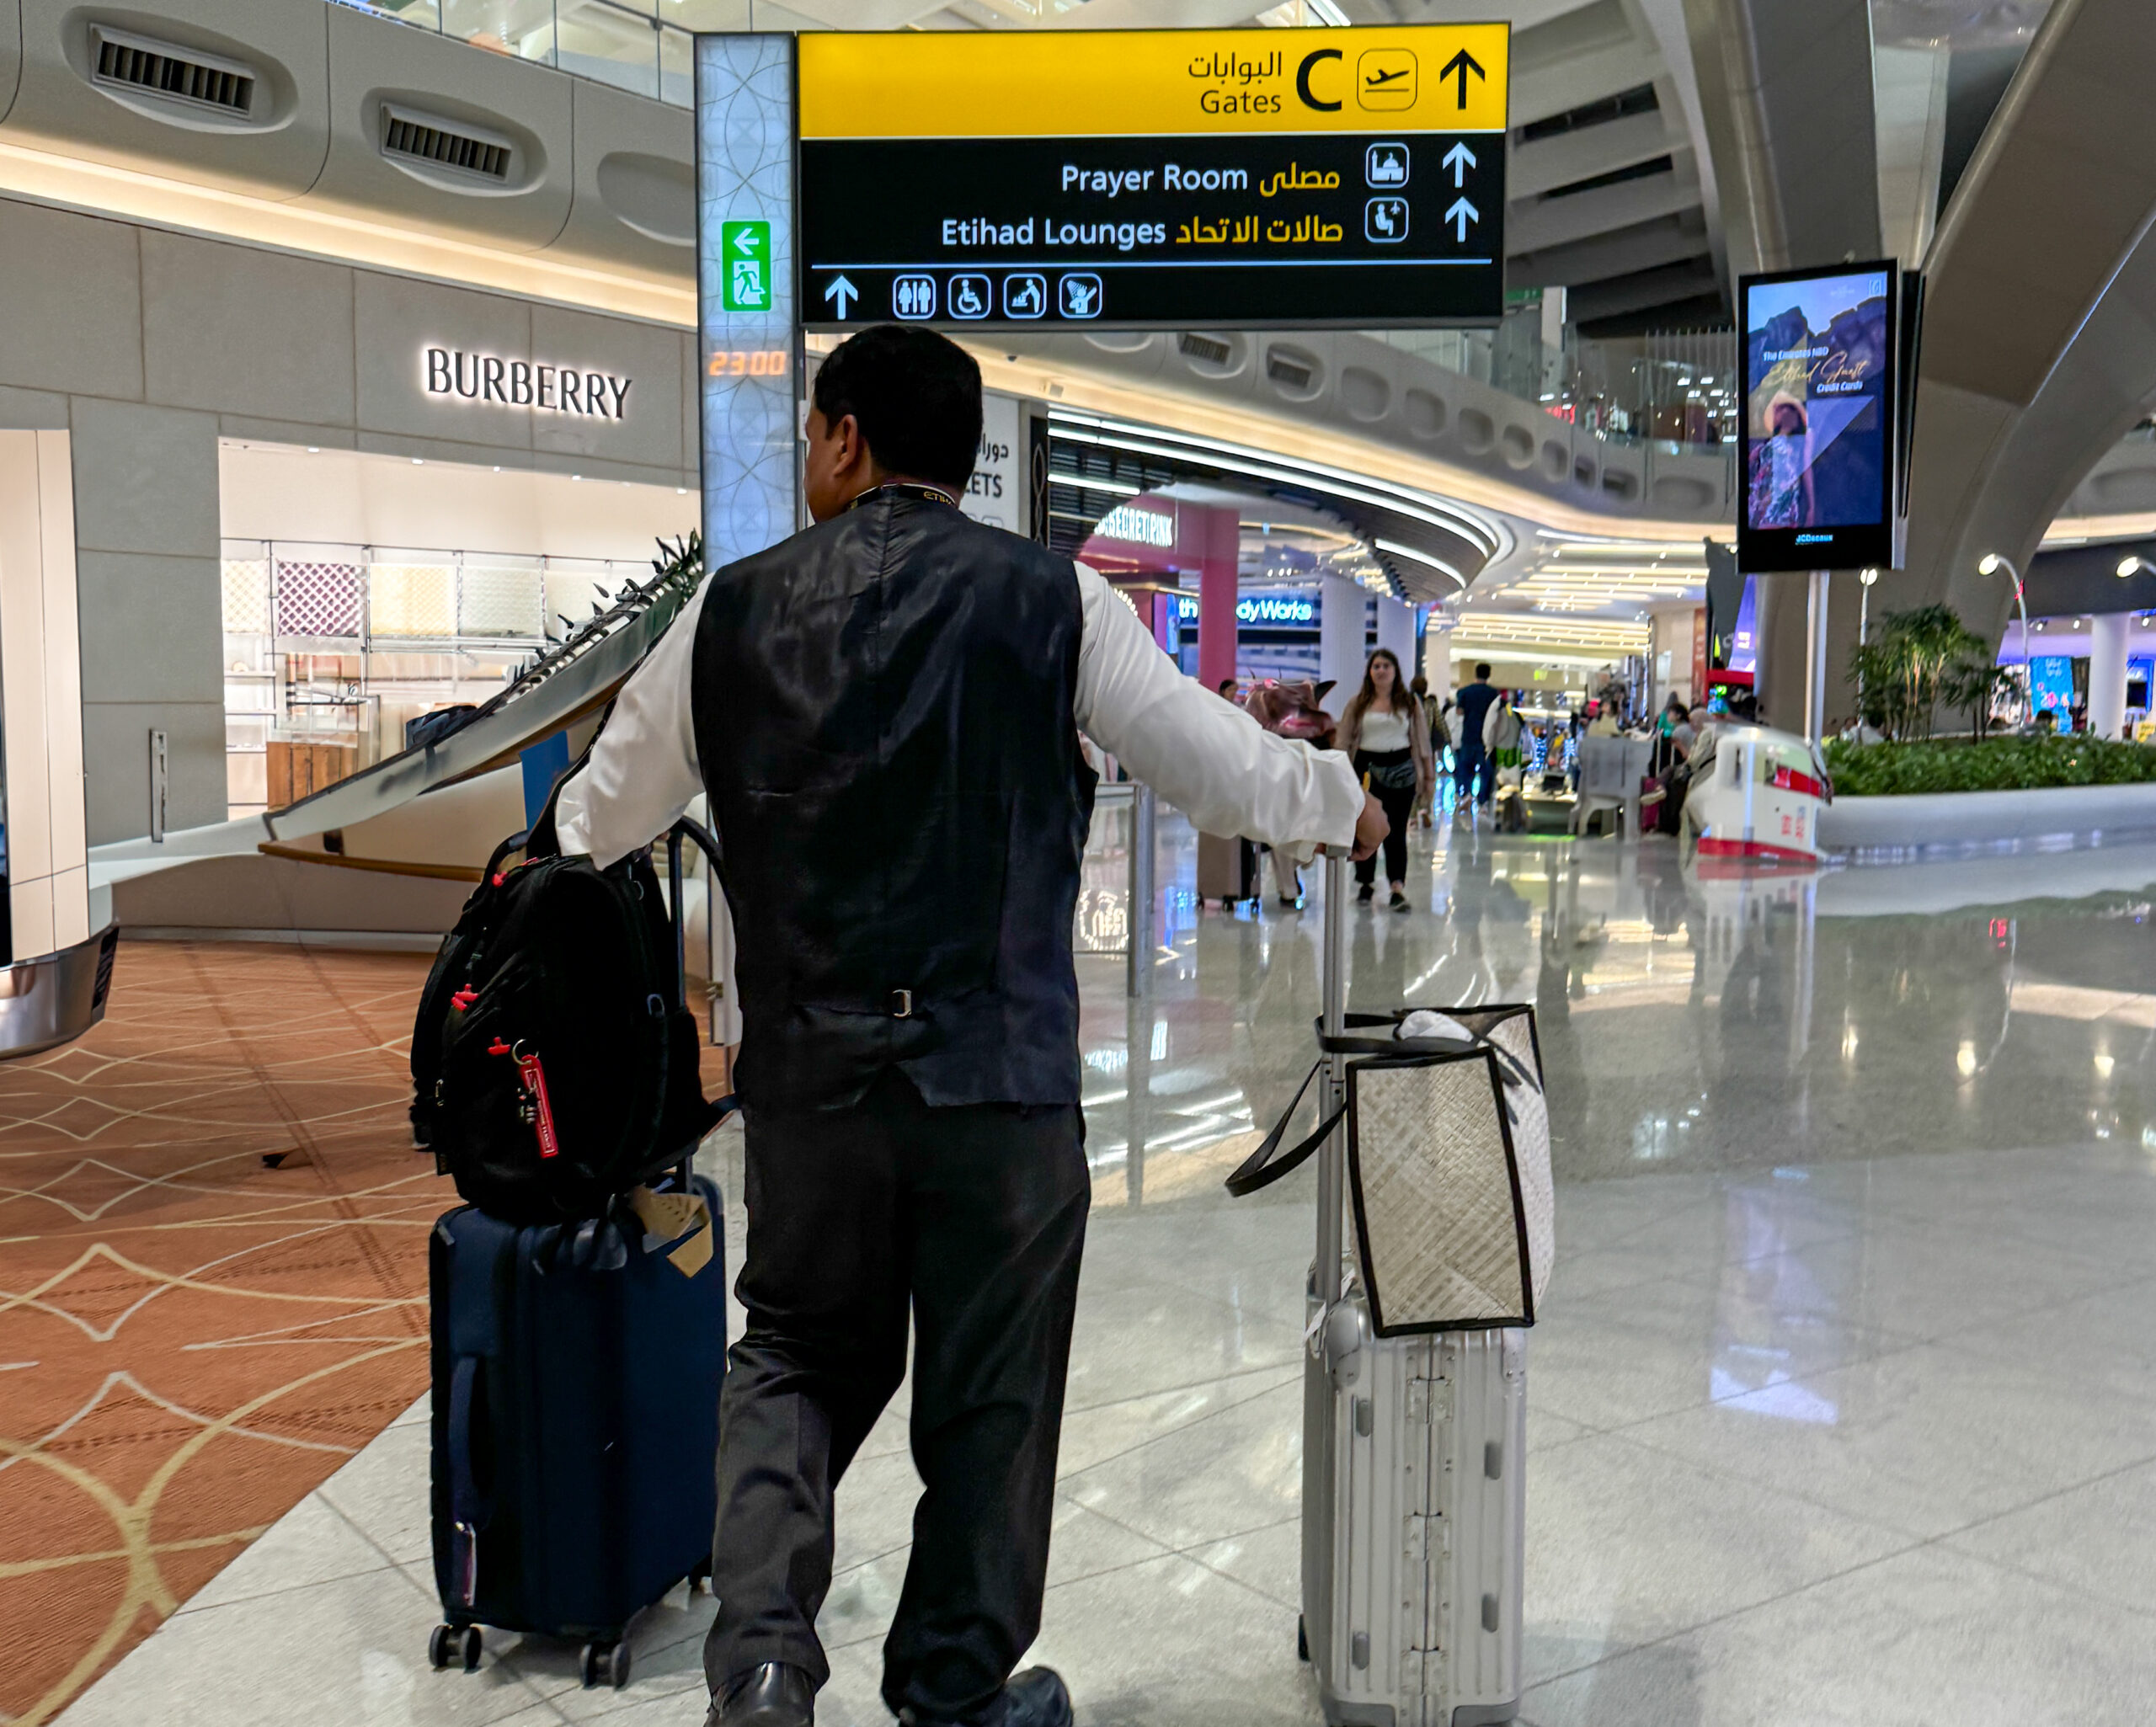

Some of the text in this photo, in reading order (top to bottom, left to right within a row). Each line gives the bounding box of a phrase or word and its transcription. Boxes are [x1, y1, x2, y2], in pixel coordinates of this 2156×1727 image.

[1188, 51, 1282, 85] البوابات
[1295, 48, 1343, 113] C
[1200, 89, 1281, 114] Gates
[1061, 164, 1248, 198] Prayer Room
[1259, 162, 1341, 198] مصلى
[942, 217, 1166, 252] Etihad Lounges
[1176, 214, 1343, 244] صالات الاتحاد
[426, 347, 633, 420] BURBERRY
[978, 433, 1009, 463] دورا
[964, 472, 1003, 498] ETS
[1178, 598, 1313, 623] th dy Works
